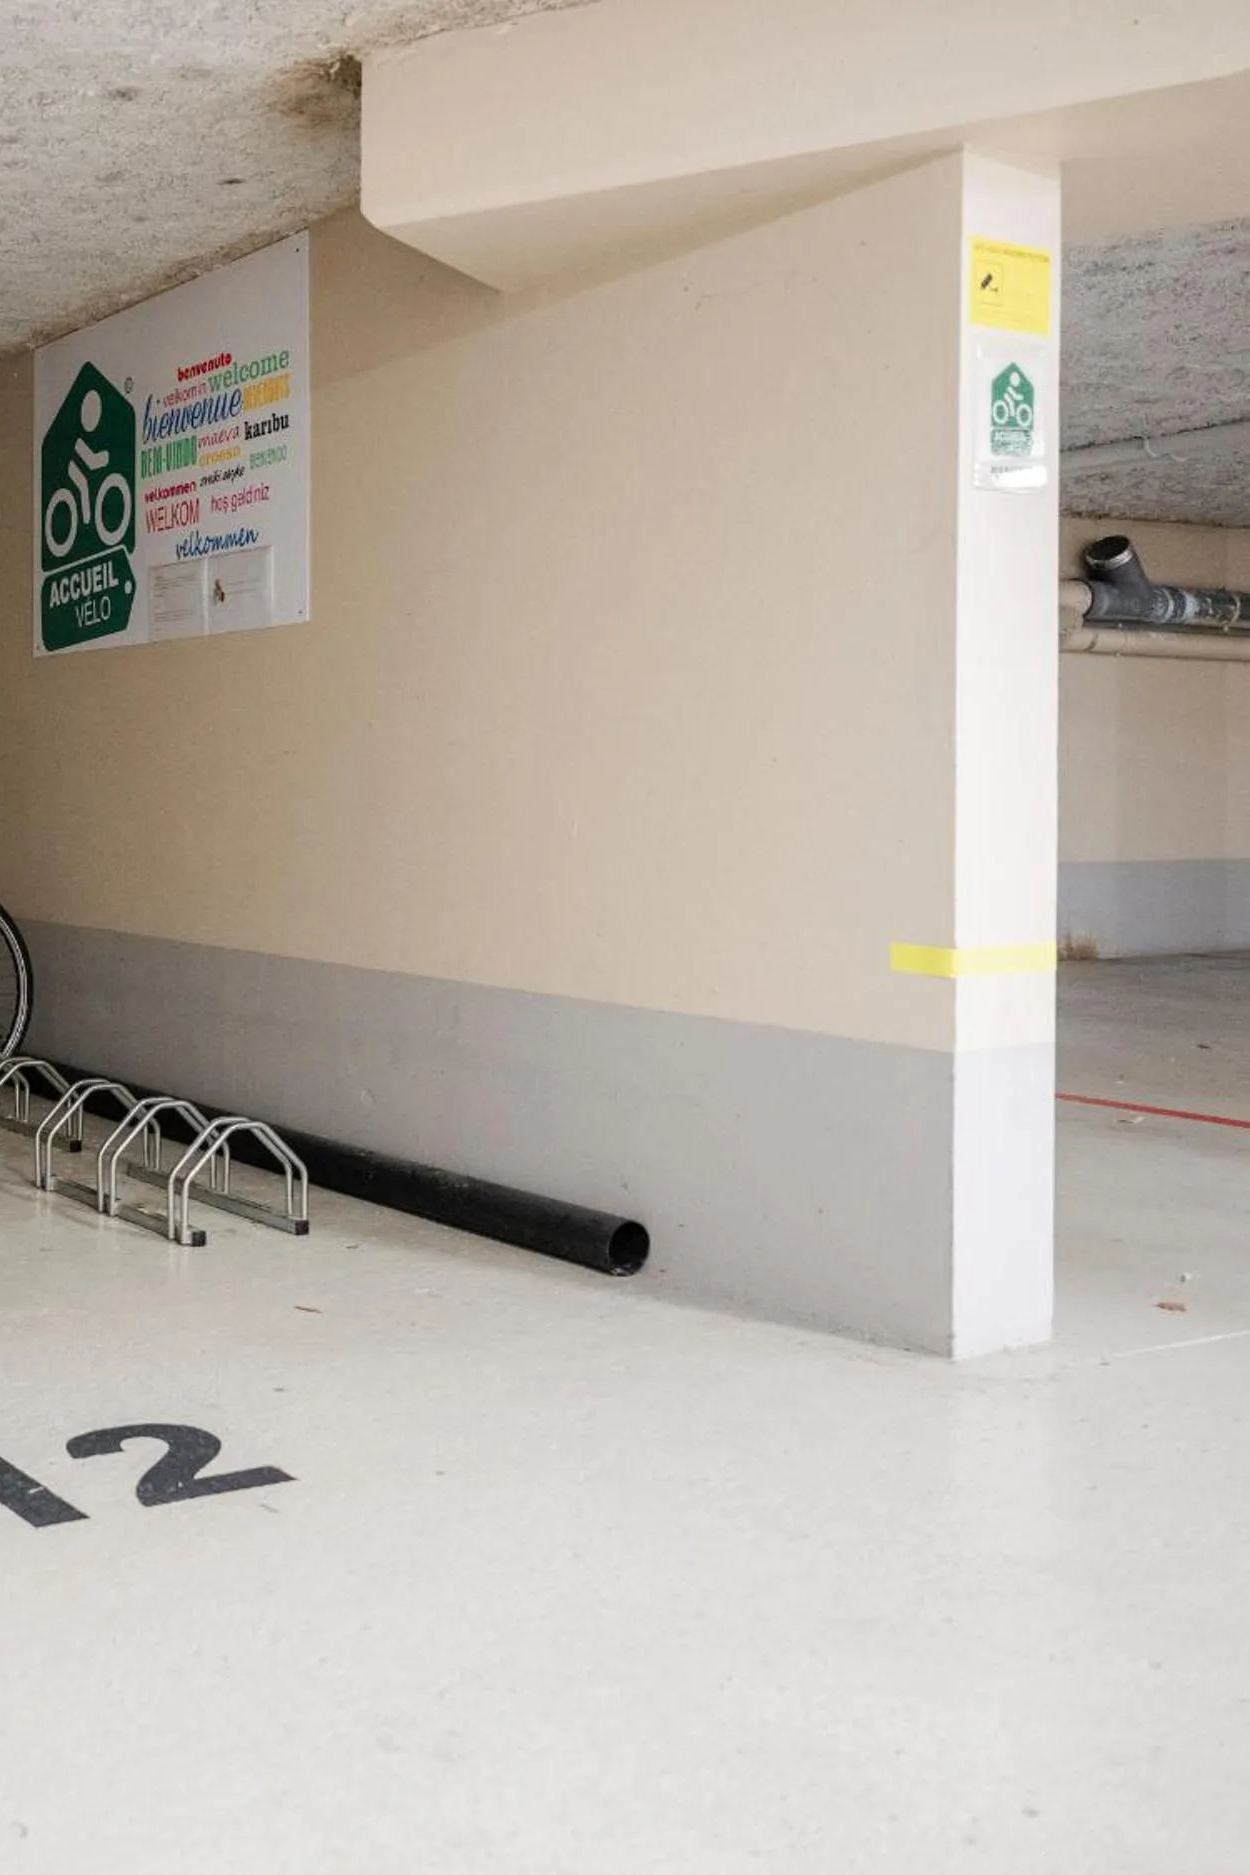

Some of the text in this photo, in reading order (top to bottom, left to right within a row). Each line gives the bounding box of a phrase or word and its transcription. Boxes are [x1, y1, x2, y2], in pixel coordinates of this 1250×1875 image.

[177, 352, 232, 382] benvenuto
[208, 350, 290, 391] welcome
[142, 388, 243, 445] bienvenue
[244, 413, 290, 441] karibu
[145, 498, 200, 533] WELKOM
[175, 527, 259, 558] velkommen
[50, 561, 119, 608] ACCUEIL
